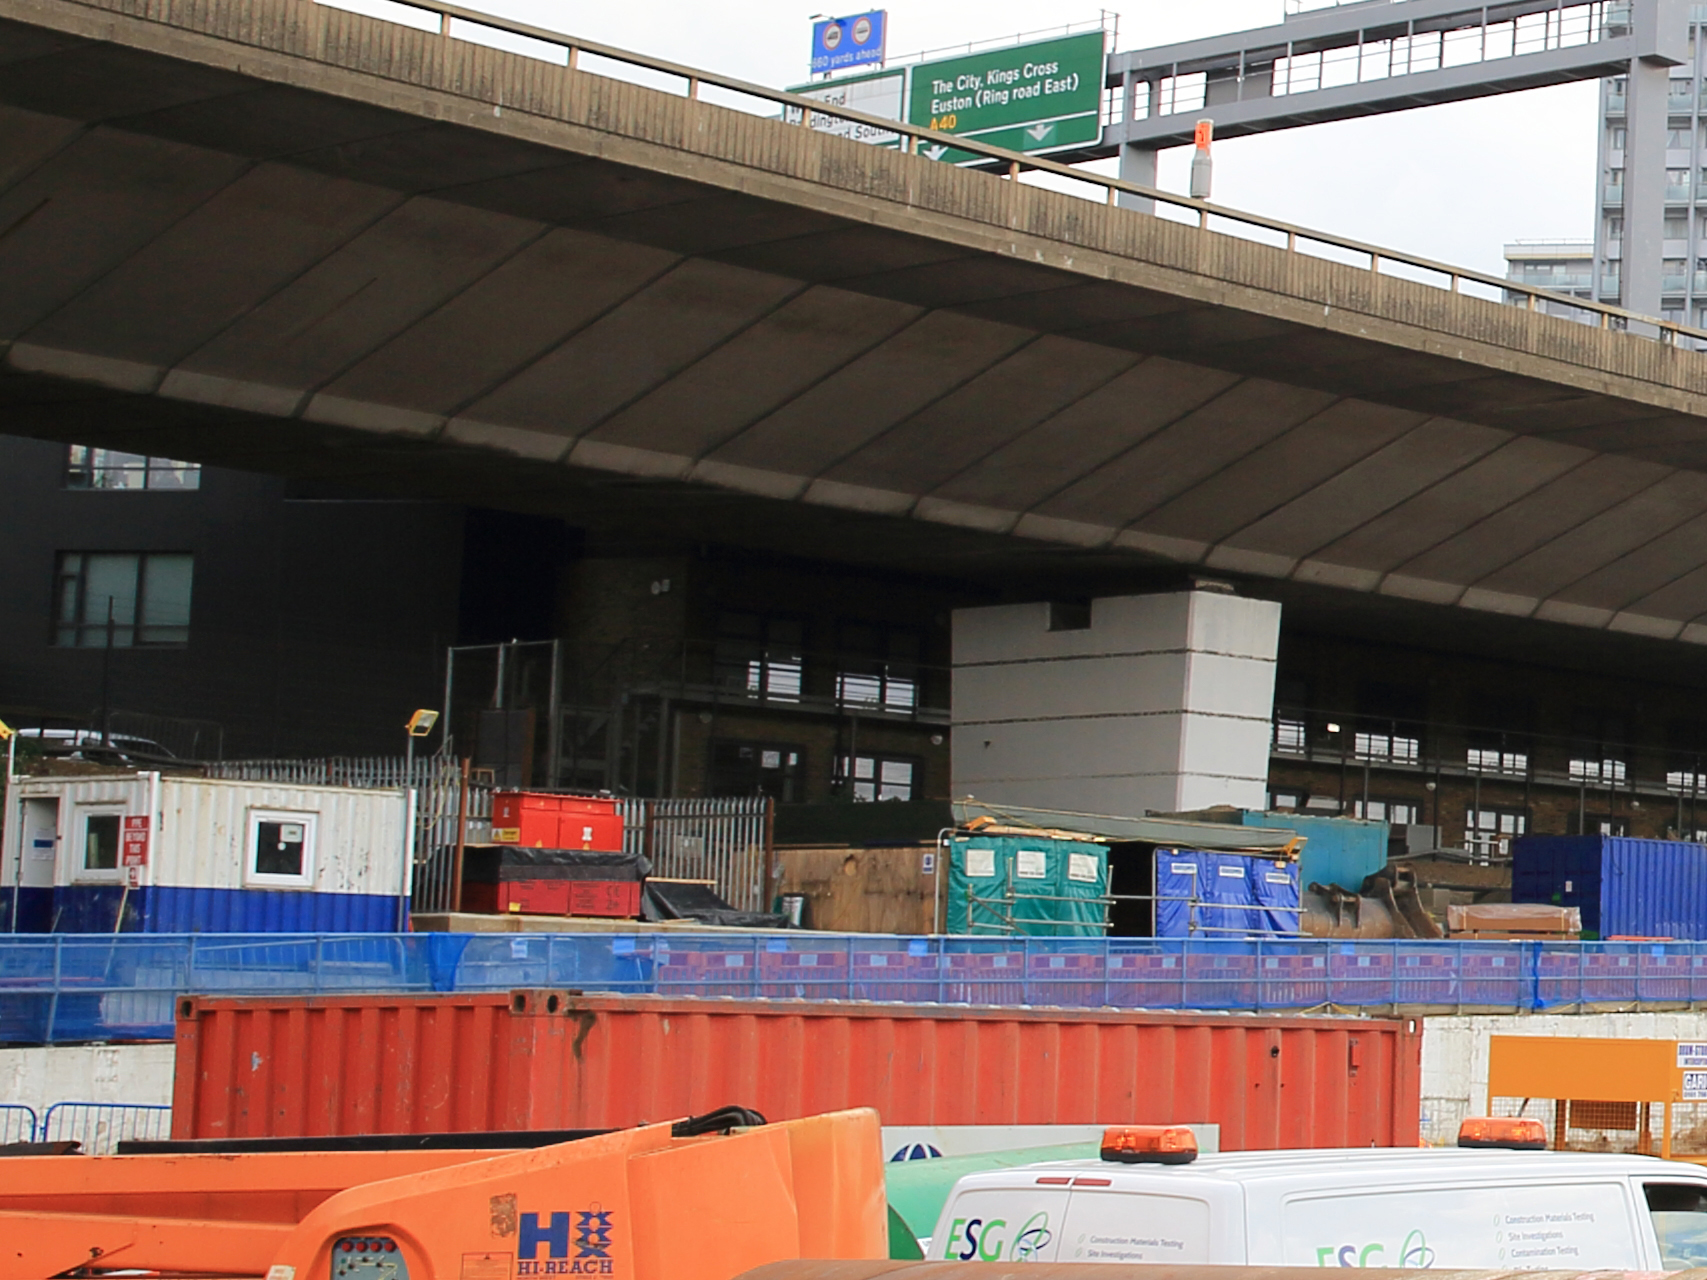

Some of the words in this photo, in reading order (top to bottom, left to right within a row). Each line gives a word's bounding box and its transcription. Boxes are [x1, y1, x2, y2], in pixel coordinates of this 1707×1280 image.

[830, 51, 854, 68] yards
[855, 48, 881, 61] ahead
[932, 80, 953, 95] The
[987, 67, 1020, 90] Kings
[1023, 61, 1059, 81] Cross
[931, 95, 973, 115] Euston
[975, 88, 1011, 110] (Ring
[1012, 82, 1041, 100] road
[1044, 72, 1080, 97] East)
[929, 114, 957, 131] A40
[1505, 1214, 1544, 1225] Construction
[1545, 1212, 1572, 1223] Materials
[1572, 1211, 1595, 1223] Testing
[945, 1218, 1007, 1262] ESG
[1089, 1235, 1129, 1247] Construction
[1130, 1237, 1159, 1247] Materials
[1159, 1239, 1185, 1251] Testing
[1511, 1246, 1555, 1258] Contamination
[1556, 1245, 1579, 1257] Testing
[518, 1261, 613, 1275] HI-REACH
